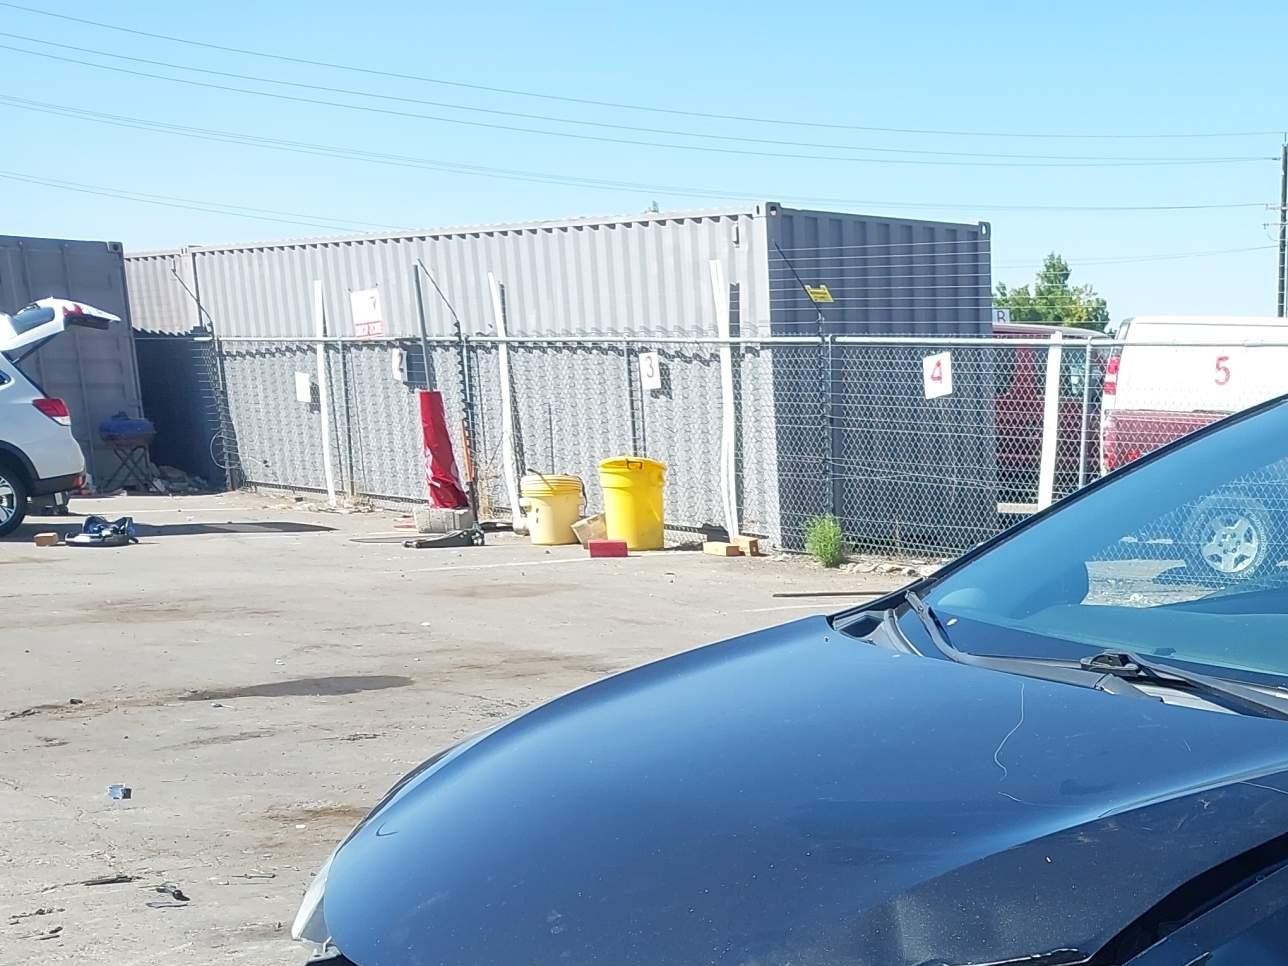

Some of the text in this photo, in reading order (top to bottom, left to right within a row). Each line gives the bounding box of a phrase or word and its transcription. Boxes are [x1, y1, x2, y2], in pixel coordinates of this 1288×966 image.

[646, 355, 655, 378] 3
[930, 360, 943, 385] 4
[1215, 356, 1231, 386] 5
